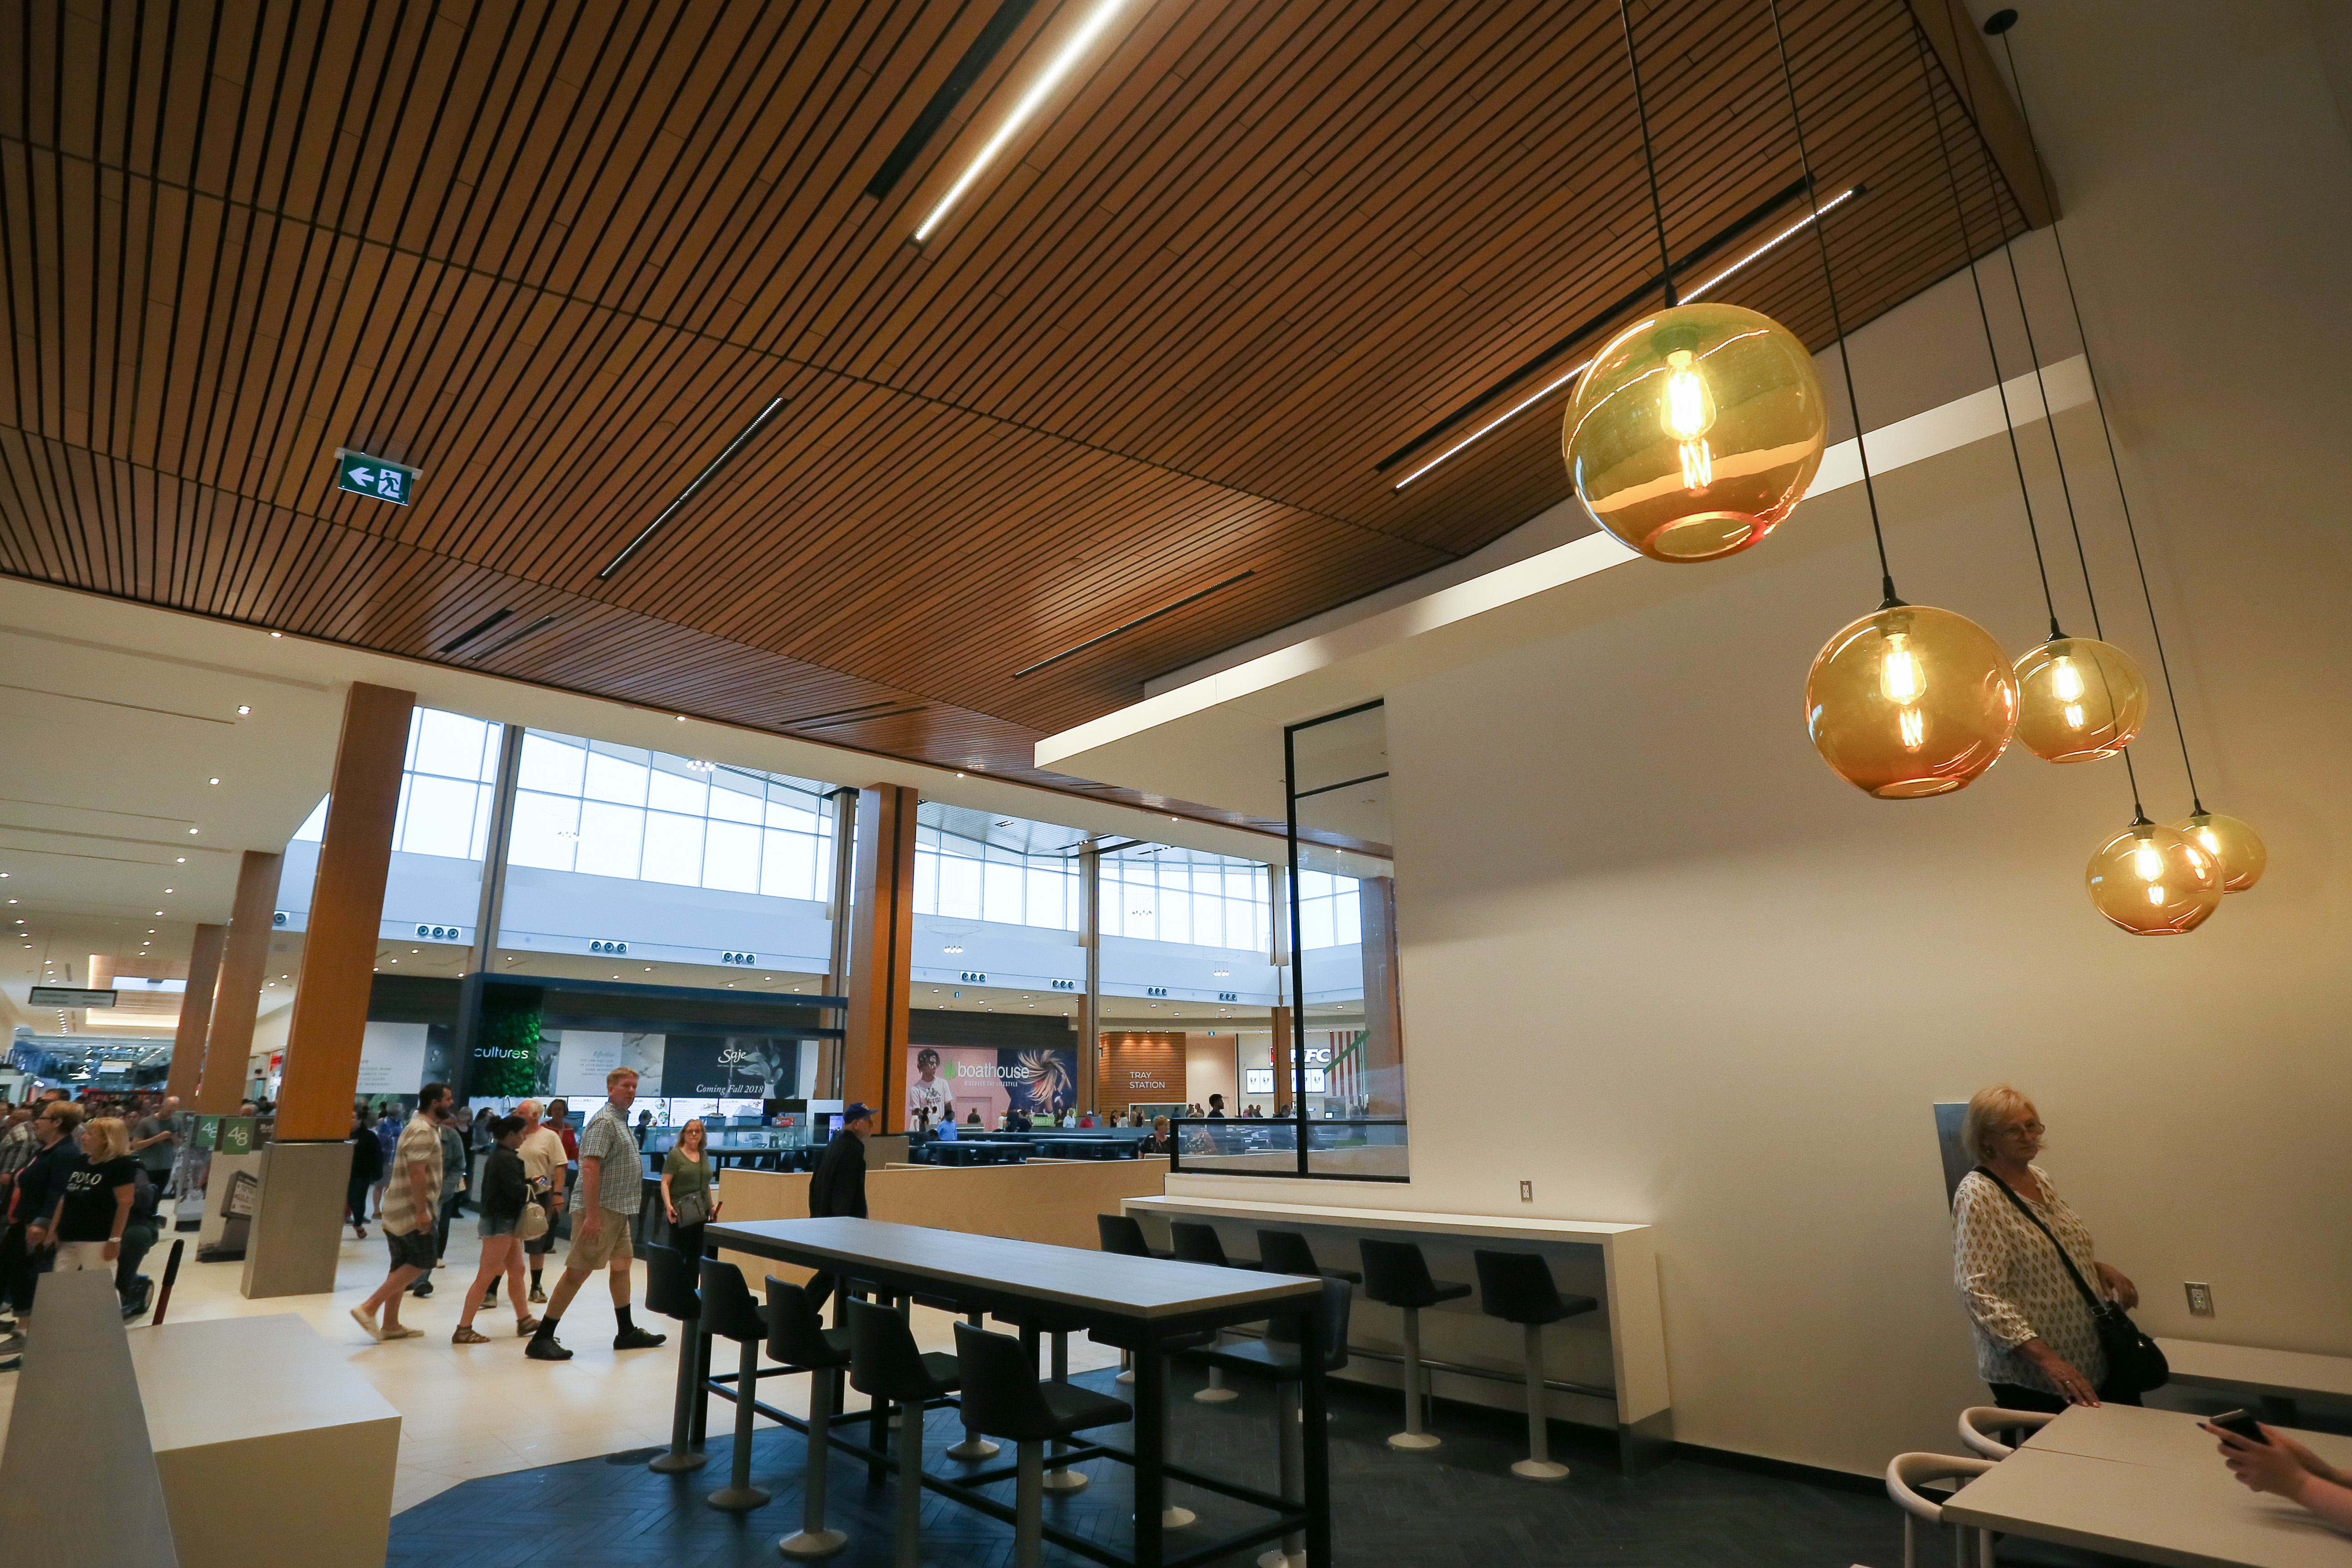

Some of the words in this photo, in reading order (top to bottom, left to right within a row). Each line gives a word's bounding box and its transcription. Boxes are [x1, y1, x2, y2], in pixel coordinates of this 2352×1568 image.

[474, 1046, 529, 1059] cultures
[718, 1049, 746, 1063] Saje
[957, 1062, 1029, 1078] boathouse
[696, 1084, 726, 1096] Coming
[227, 1126, 248, 1146] 48
[68, 1171, 102, 1185] POLO
